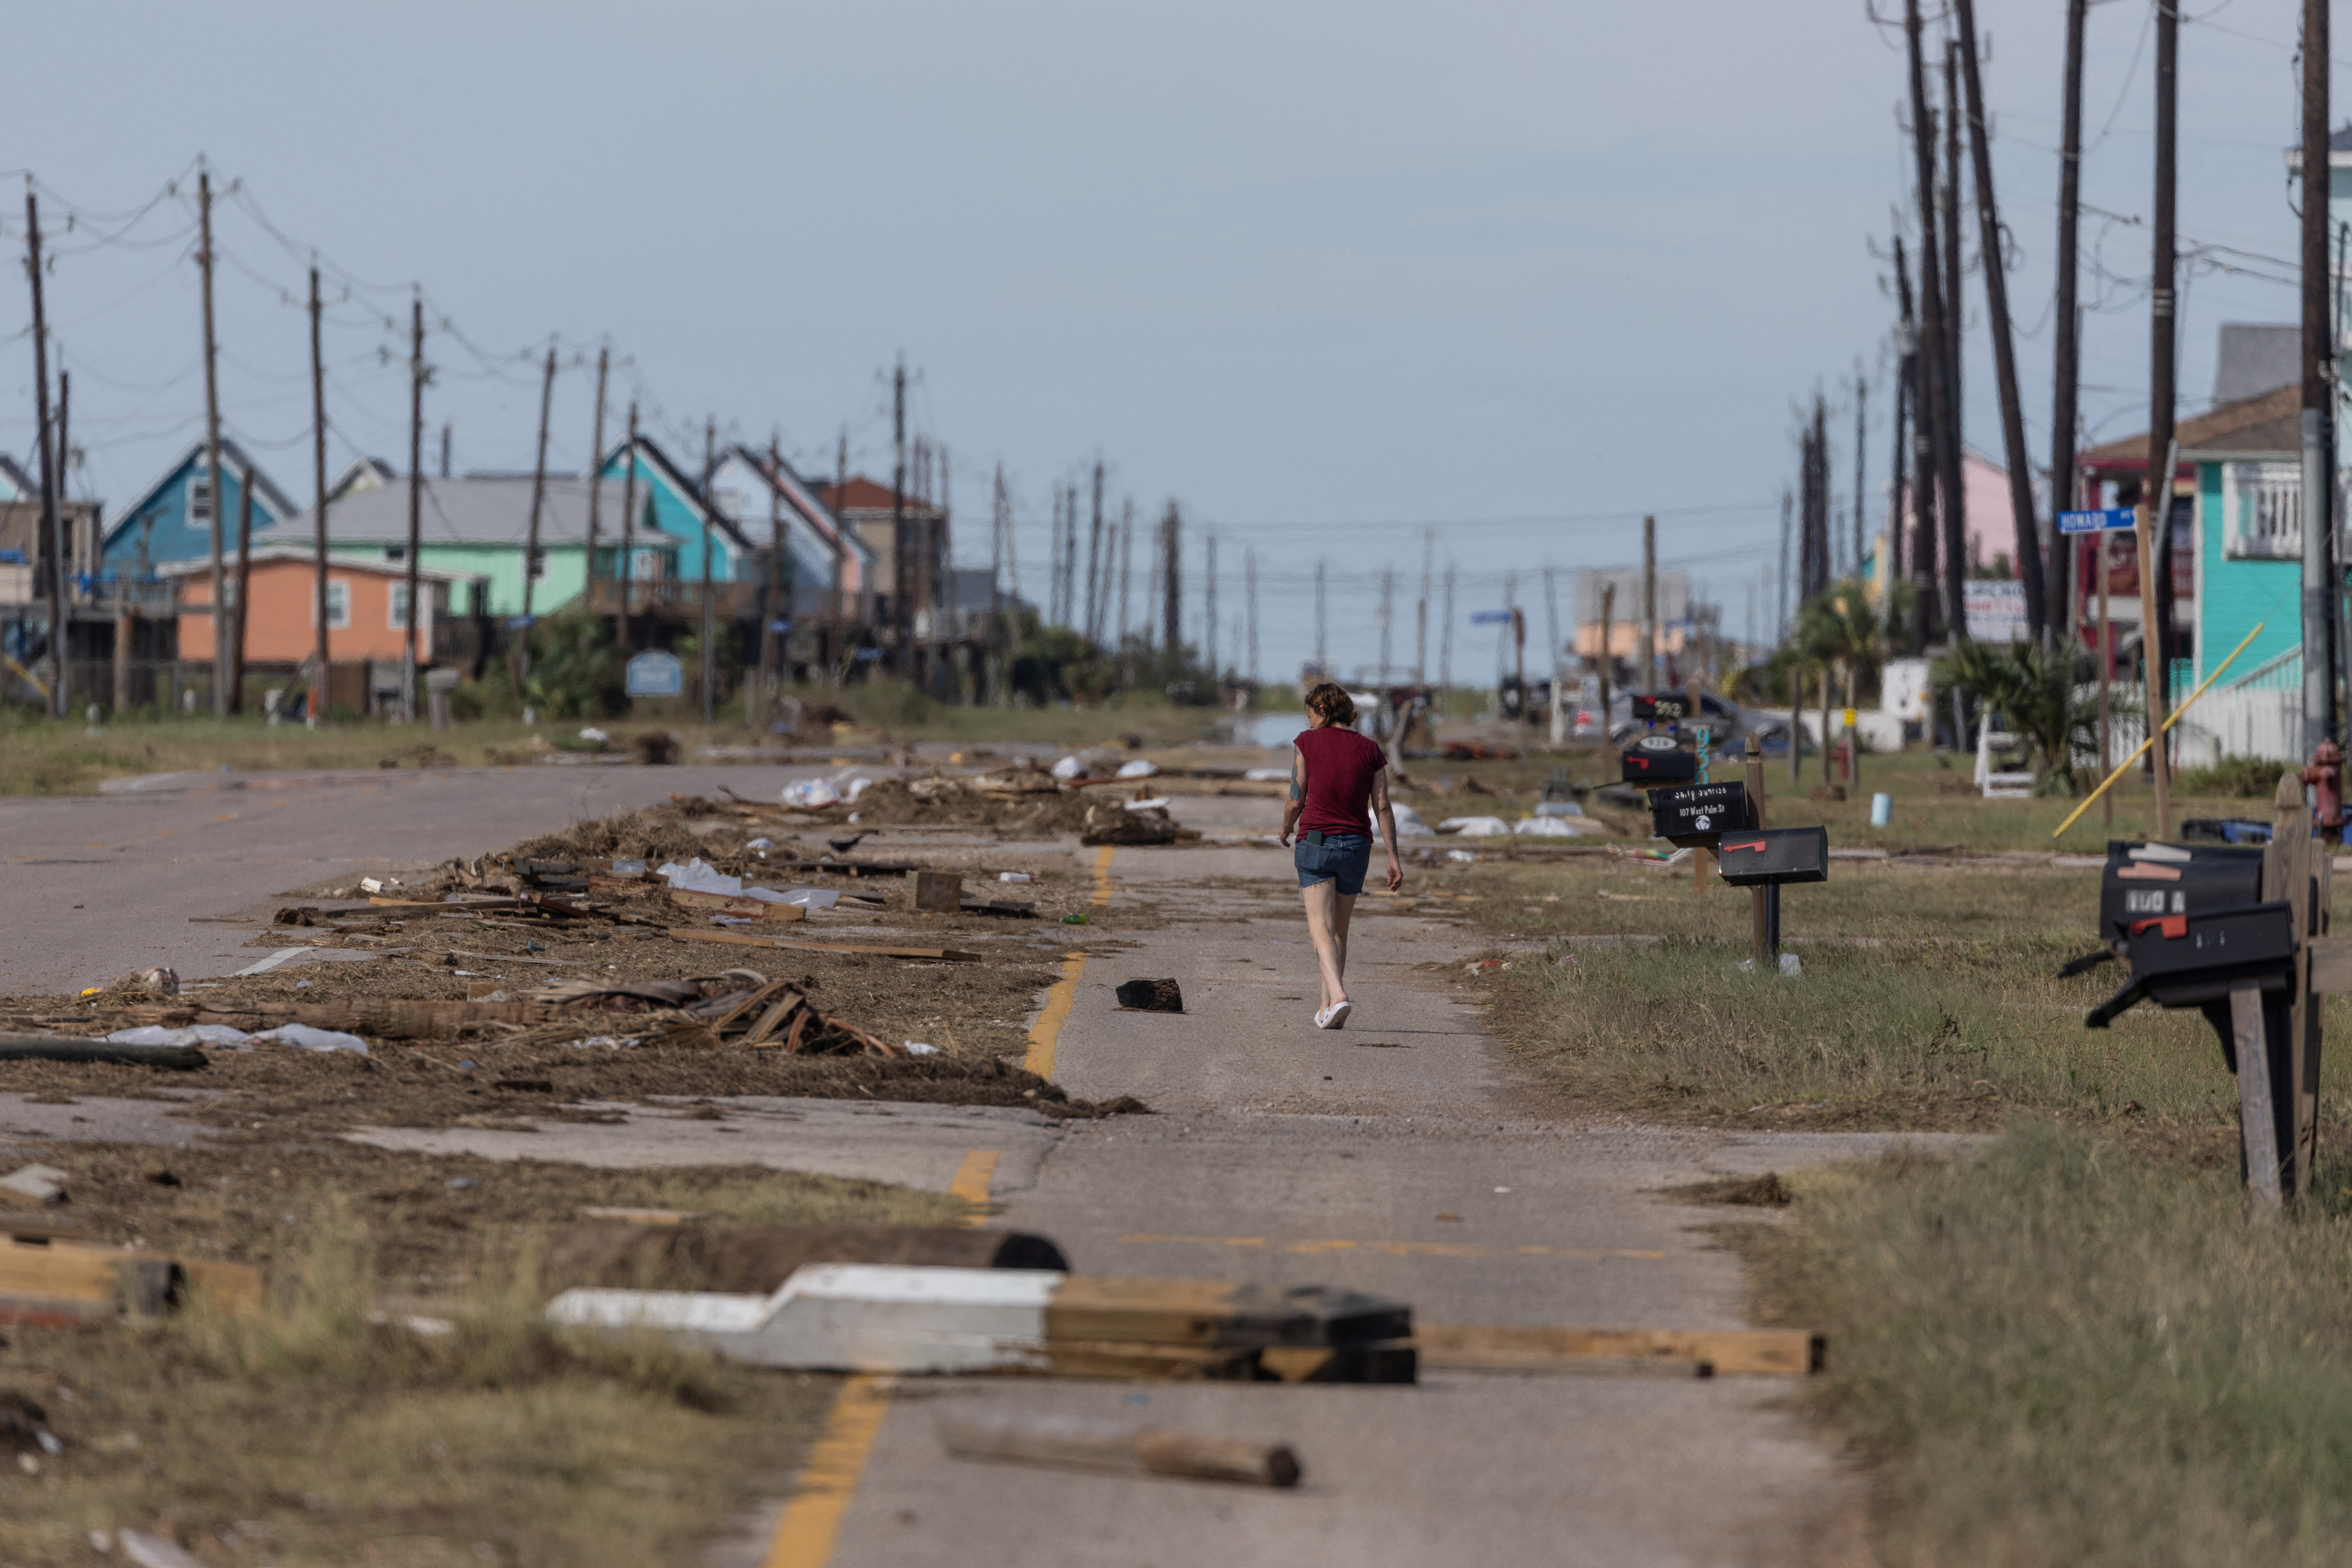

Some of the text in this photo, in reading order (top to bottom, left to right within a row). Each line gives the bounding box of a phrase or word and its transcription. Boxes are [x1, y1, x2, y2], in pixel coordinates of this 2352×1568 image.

[2061, 512, 2108, 529] HOWARD
[1695, 728, 1710, 784] 930
[1679, 808, 1689, 817] 107
[1690, 806, 1704, 815] West
[1704, 804, 1717, 814] Palm
